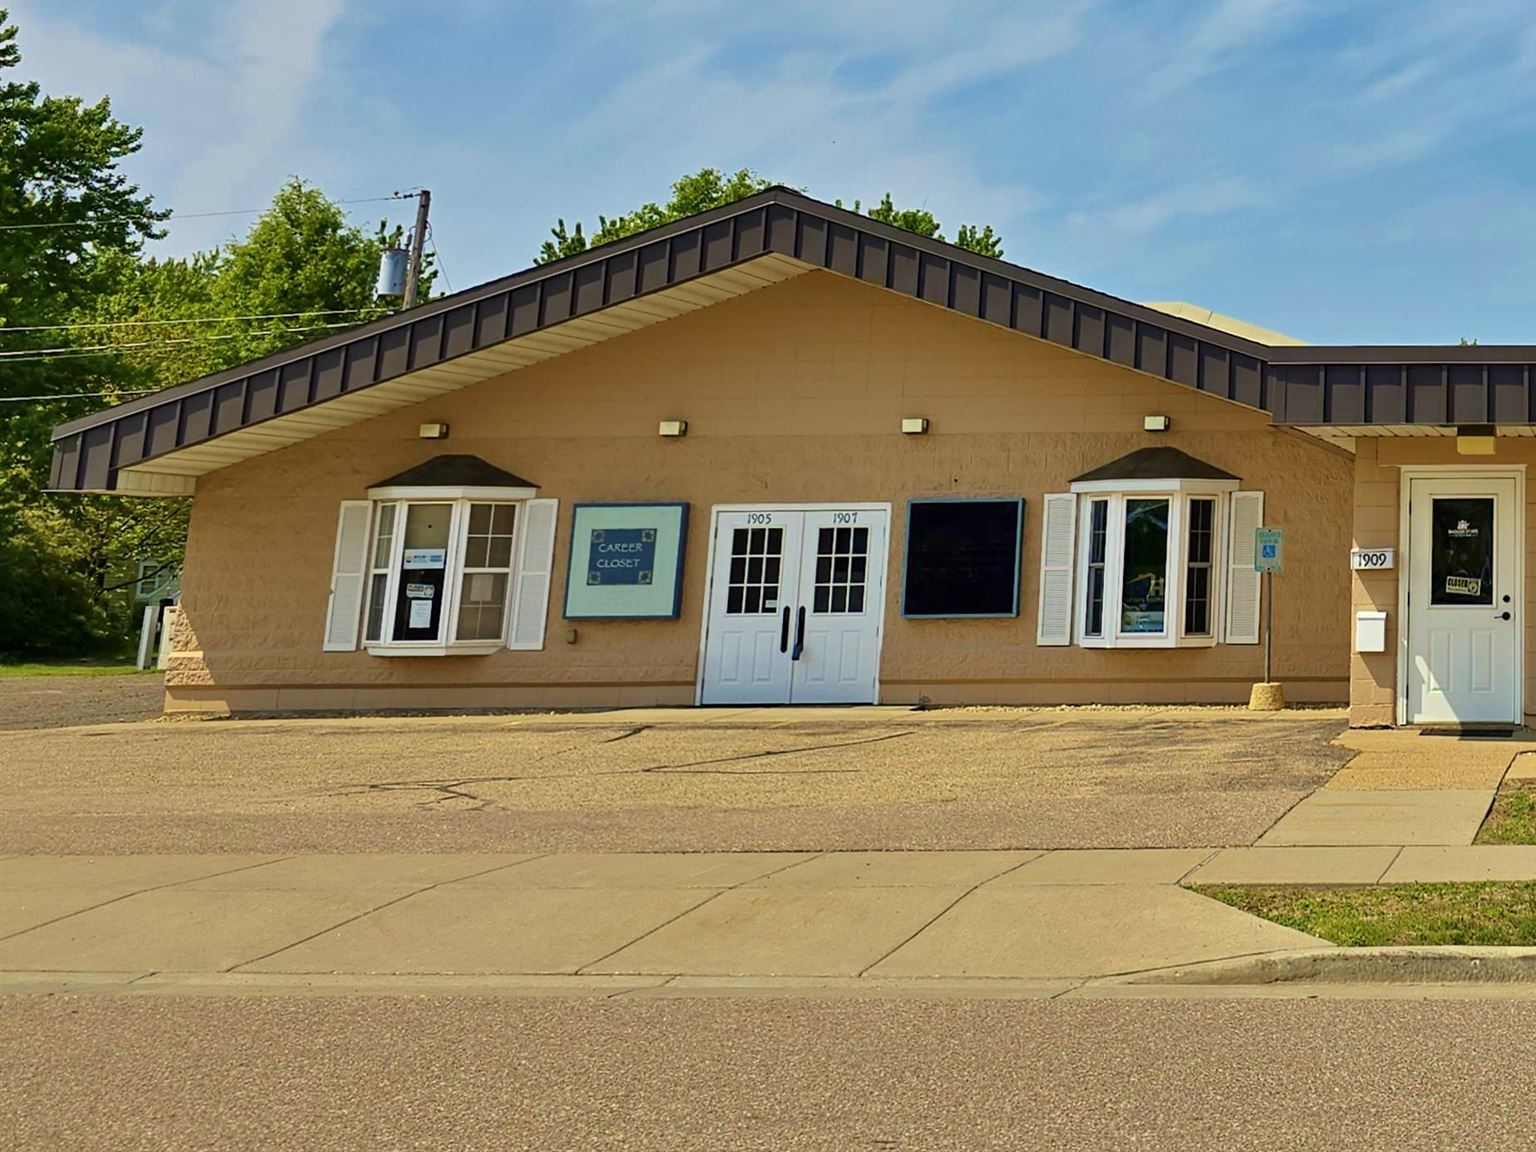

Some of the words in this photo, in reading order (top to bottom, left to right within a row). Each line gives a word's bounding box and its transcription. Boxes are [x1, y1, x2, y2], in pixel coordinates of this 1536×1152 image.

[747, 513, 772, 524] 1905
[833, 512, 858, 523] 1907
[598, 543, 643, 552] CAREER
[596, 558, 641, 568] CLOSET
[1358, 553, 1387, 567] 1909
[1447, 578, 1468, 588] CLOSED
